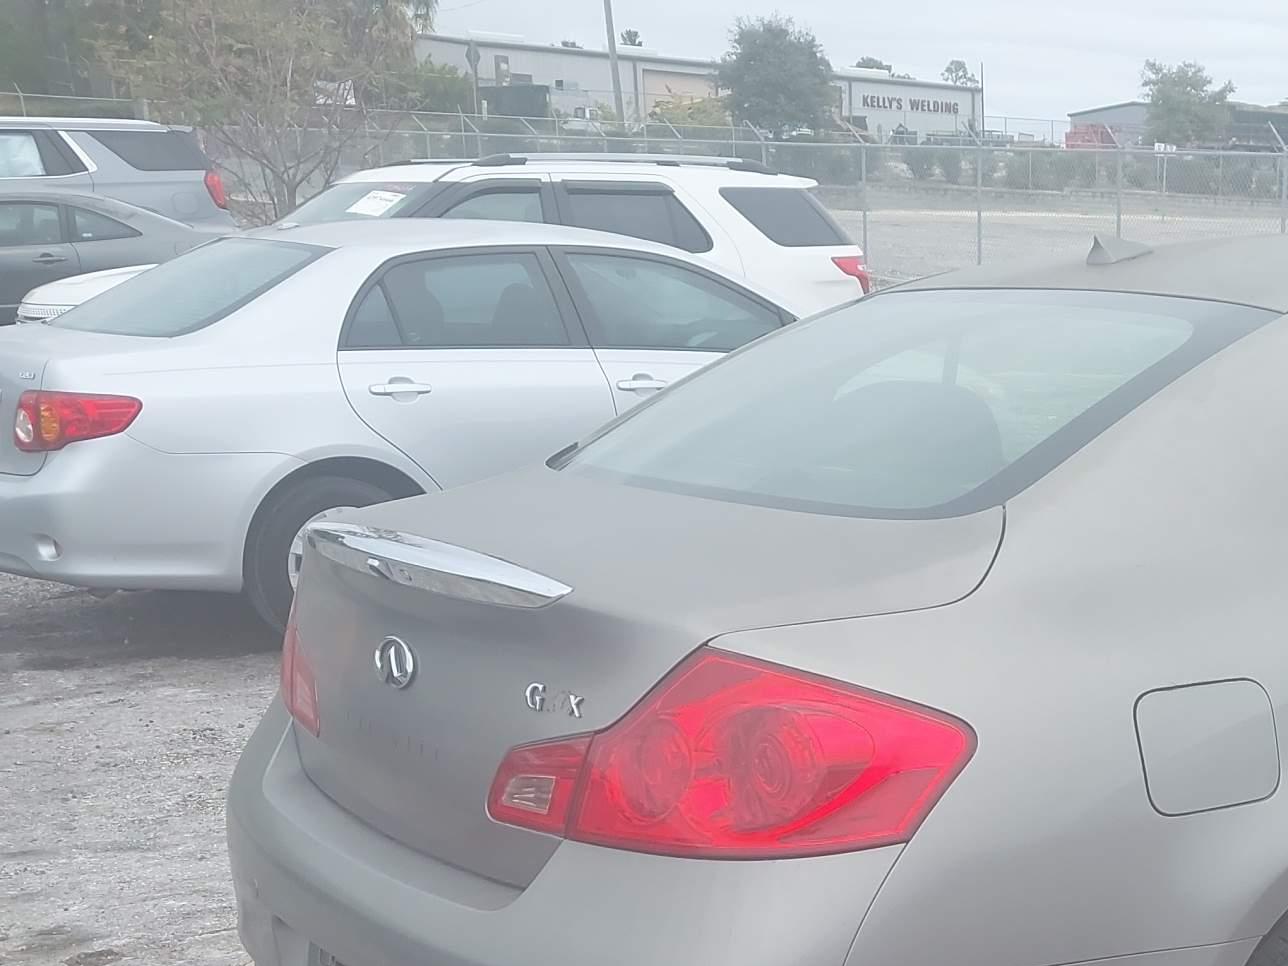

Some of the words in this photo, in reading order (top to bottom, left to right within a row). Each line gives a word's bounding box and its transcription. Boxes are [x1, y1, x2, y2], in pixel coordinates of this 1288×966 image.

[862, 94, 903, 110] KELLY'S
[909, 98, 959, 114] WELDING
[525, 682, 546, 712] G
